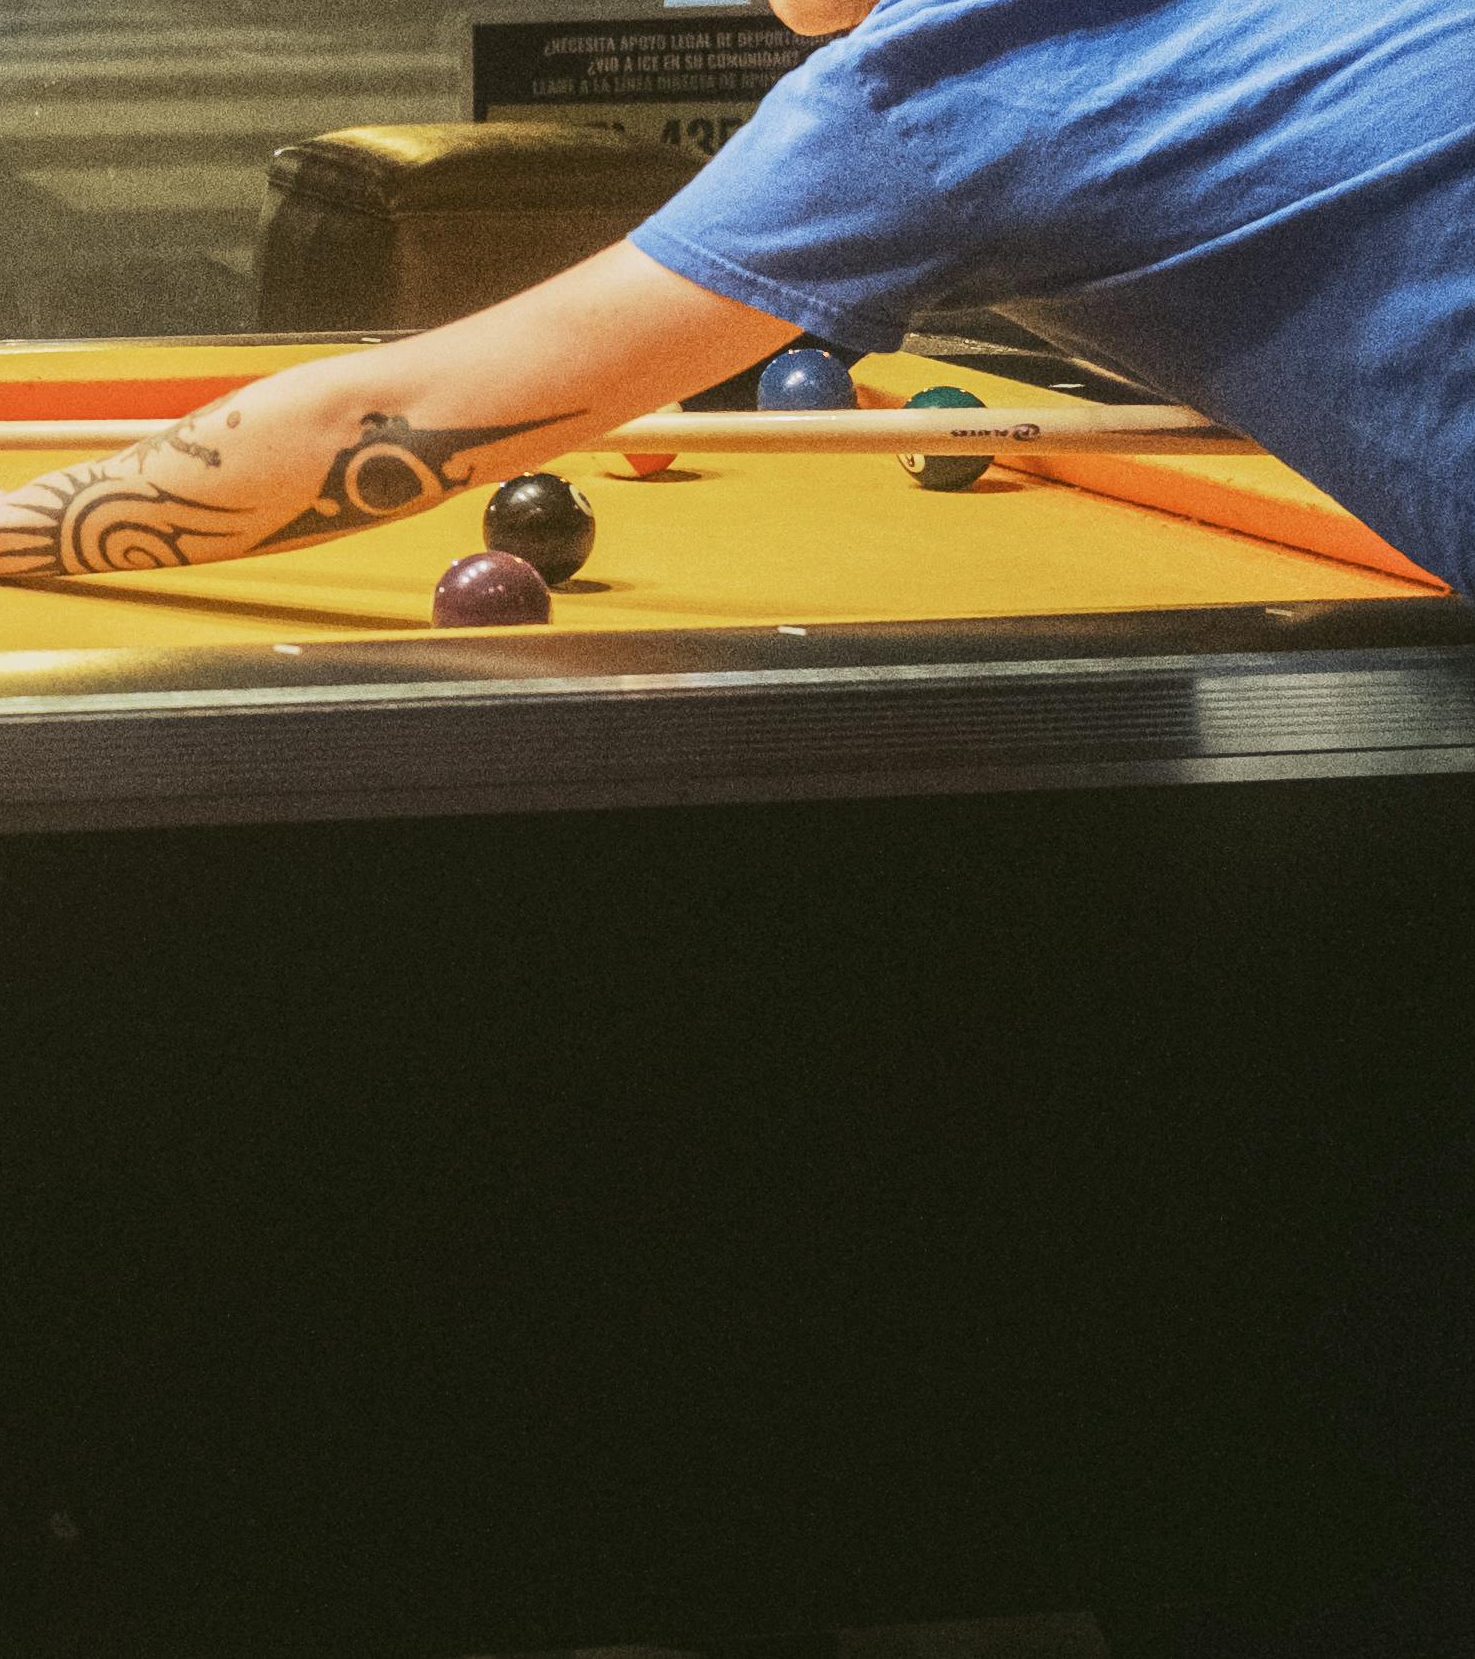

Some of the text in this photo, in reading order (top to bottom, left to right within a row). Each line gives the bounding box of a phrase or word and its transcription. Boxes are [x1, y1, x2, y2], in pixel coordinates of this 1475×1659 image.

[543, 37, 616, 56] ¿NECESITA
[620, 34, 667, 51] APOYO
[671, 32, 711, 50] LEGAL
[587, 55, 620, 77] ¿VIO
[624, 56, 634, 72] A
[637, 54, 660, 72] ICE
[663, 54, 681, 71] EN
[684, 53, 704, 70] SU
